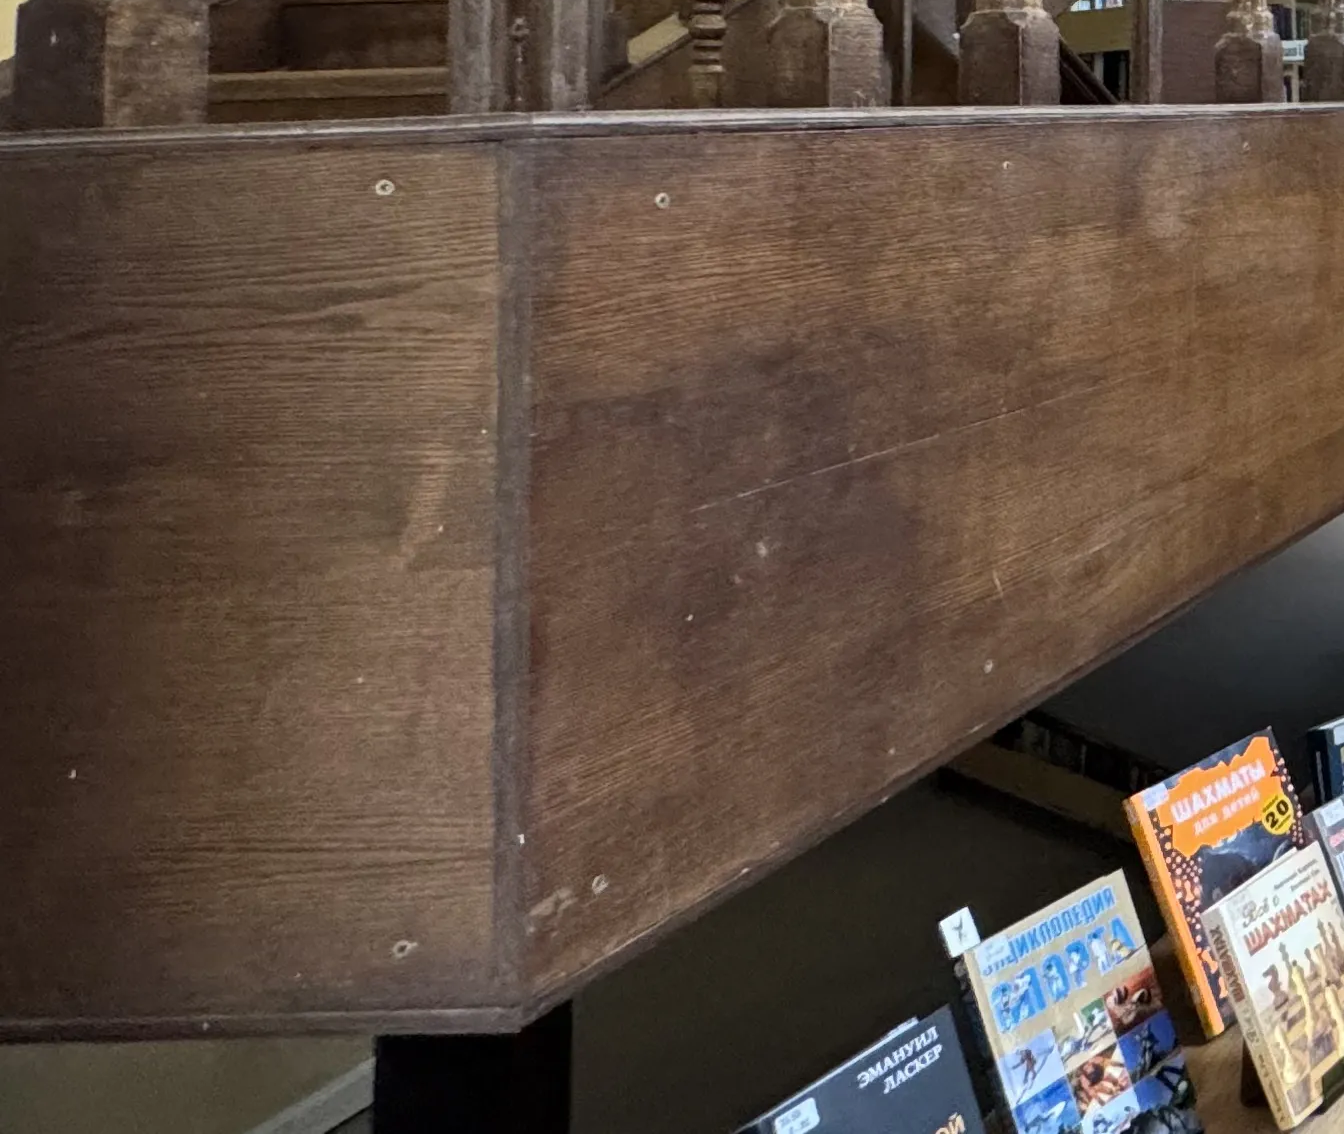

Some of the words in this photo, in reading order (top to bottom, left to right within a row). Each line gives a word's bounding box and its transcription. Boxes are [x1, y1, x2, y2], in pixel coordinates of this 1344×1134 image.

[1170, 758, 1266, 824] ШАХМАТЫ
[1264, 798, 1290, 829] 20
[1243, 878, 1332, 957] ШАХМАТАХ
[856, 1025, 940, 1090] ЭМАНУИЛ
[883, 1043, 944, 1095] ЛАСКЕР
